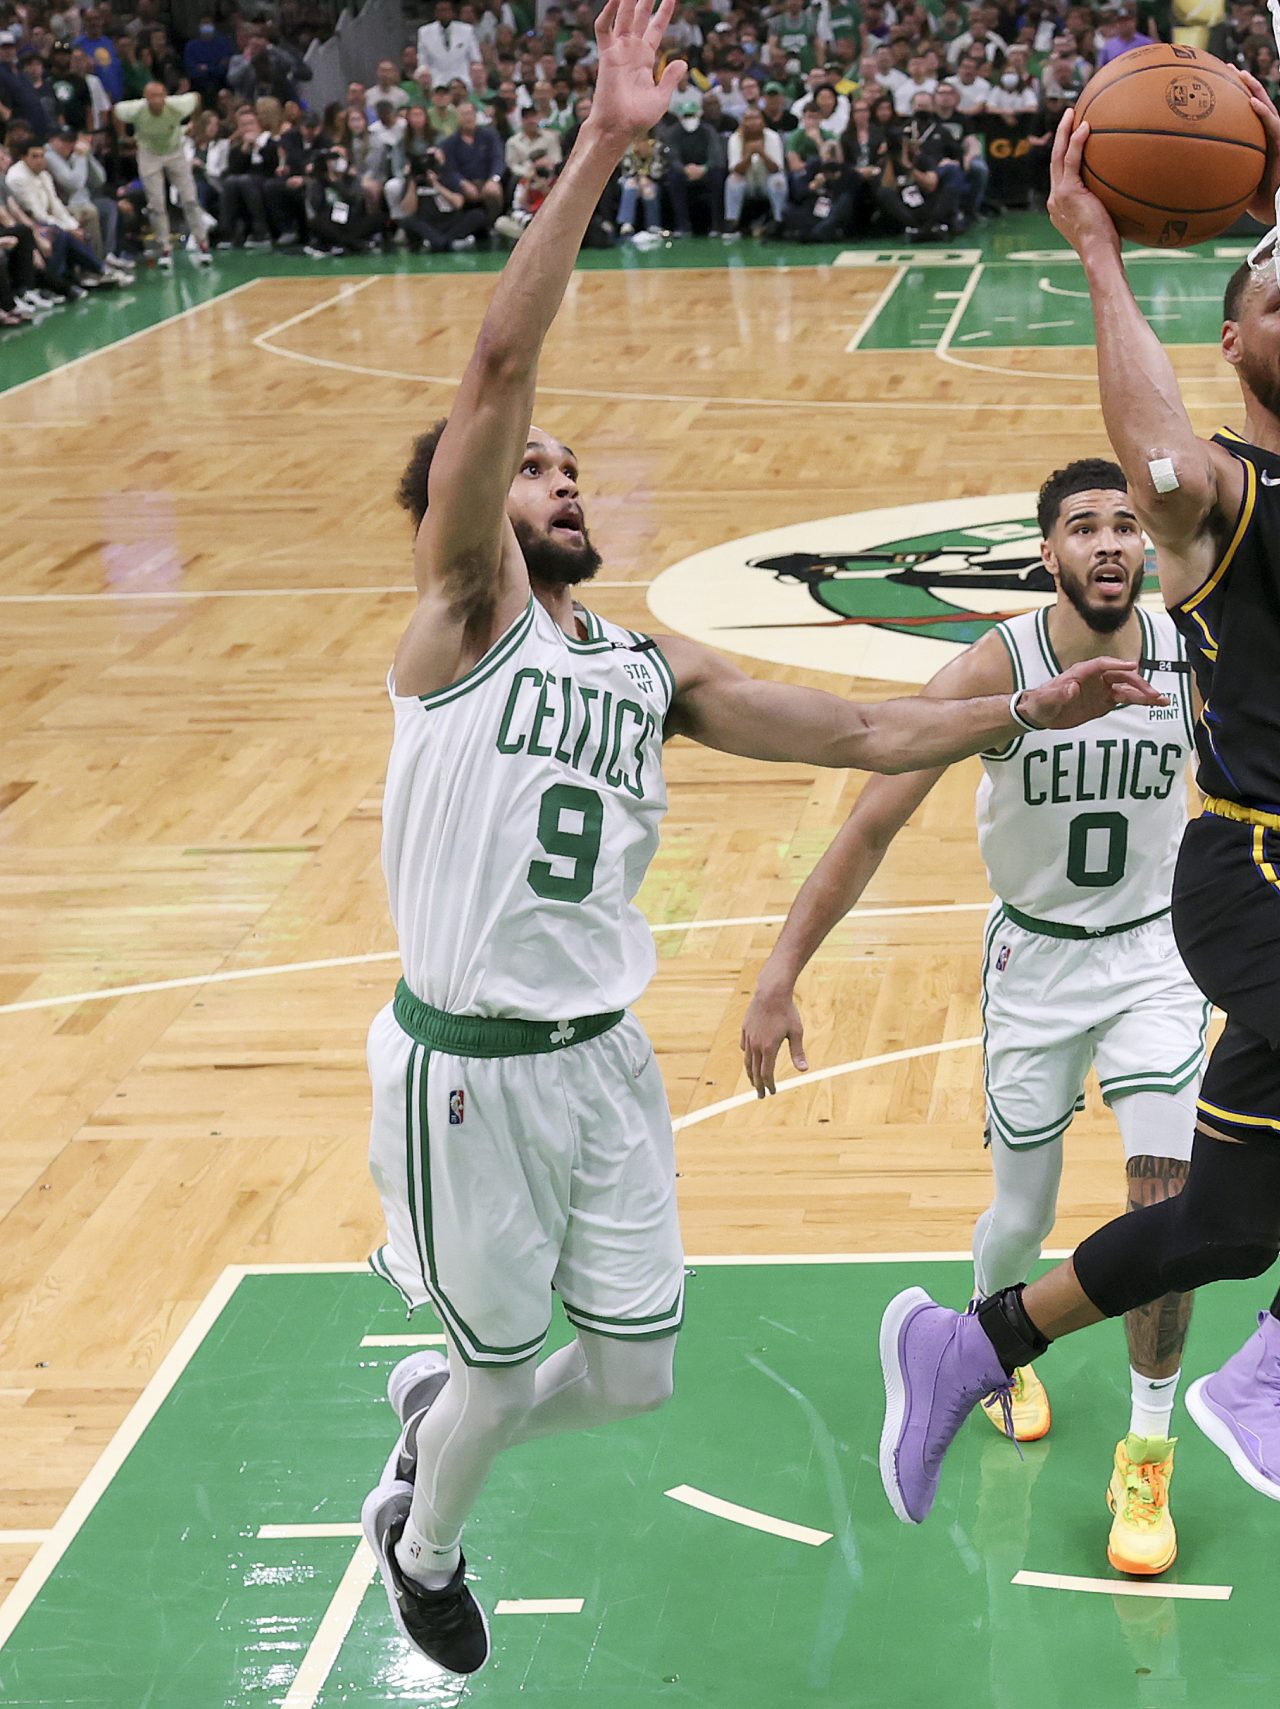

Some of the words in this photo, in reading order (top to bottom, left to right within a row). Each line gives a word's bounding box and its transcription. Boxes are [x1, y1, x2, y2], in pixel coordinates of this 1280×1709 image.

[1158, 661, 1172, 671] 24
[496, 667, 655, 800] CELTICS
[1149, 708, 1179, 721] PRINT
[1023, 739, 1182, 806] CELTICS
[526, 783, 604, 904] 9
[1066, 811, 1129, 887] 0
